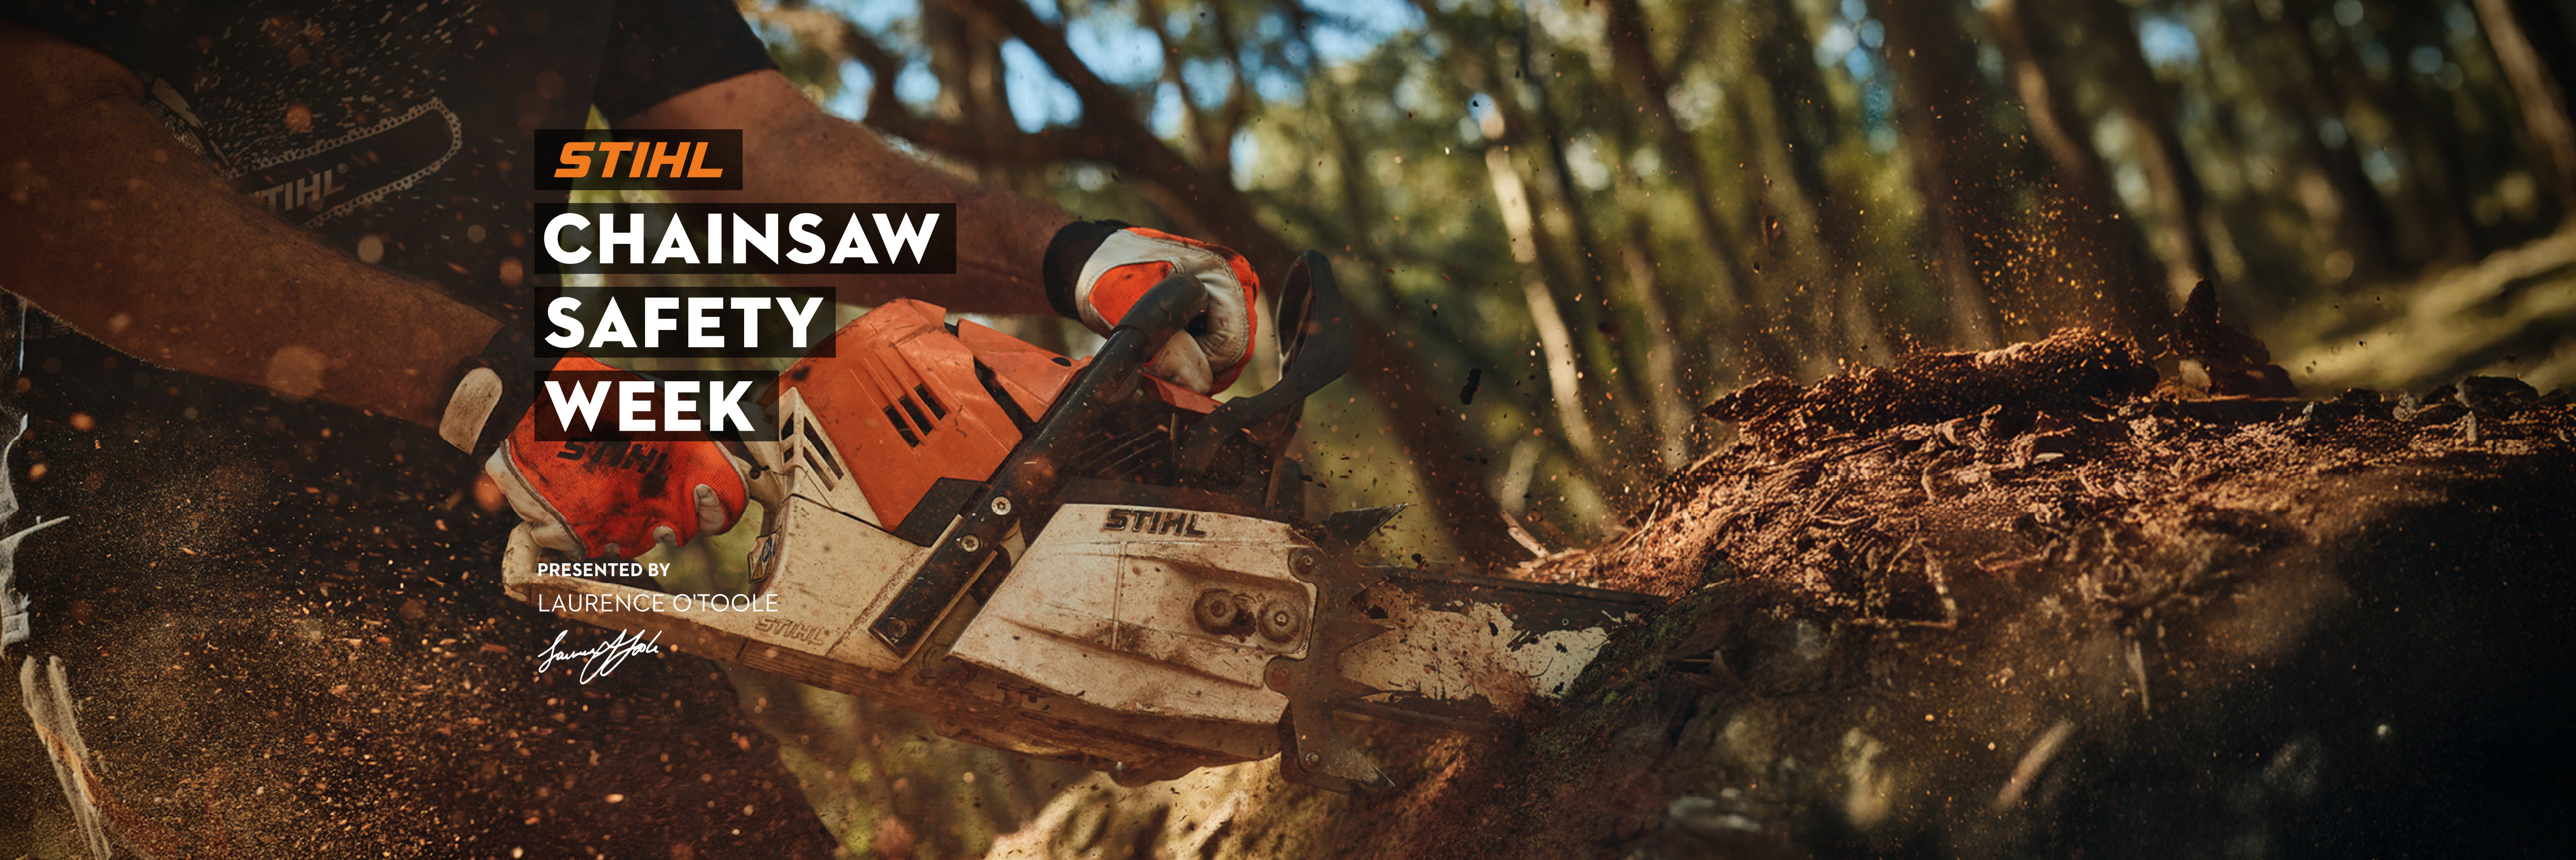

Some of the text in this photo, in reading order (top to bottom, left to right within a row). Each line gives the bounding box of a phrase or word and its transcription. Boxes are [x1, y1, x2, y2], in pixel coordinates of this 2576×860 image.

[249, 169, 345, 211] TIHL
[1104, 508, 1206, 538] STIHL
[755, 617, 824, 646] STIHL
